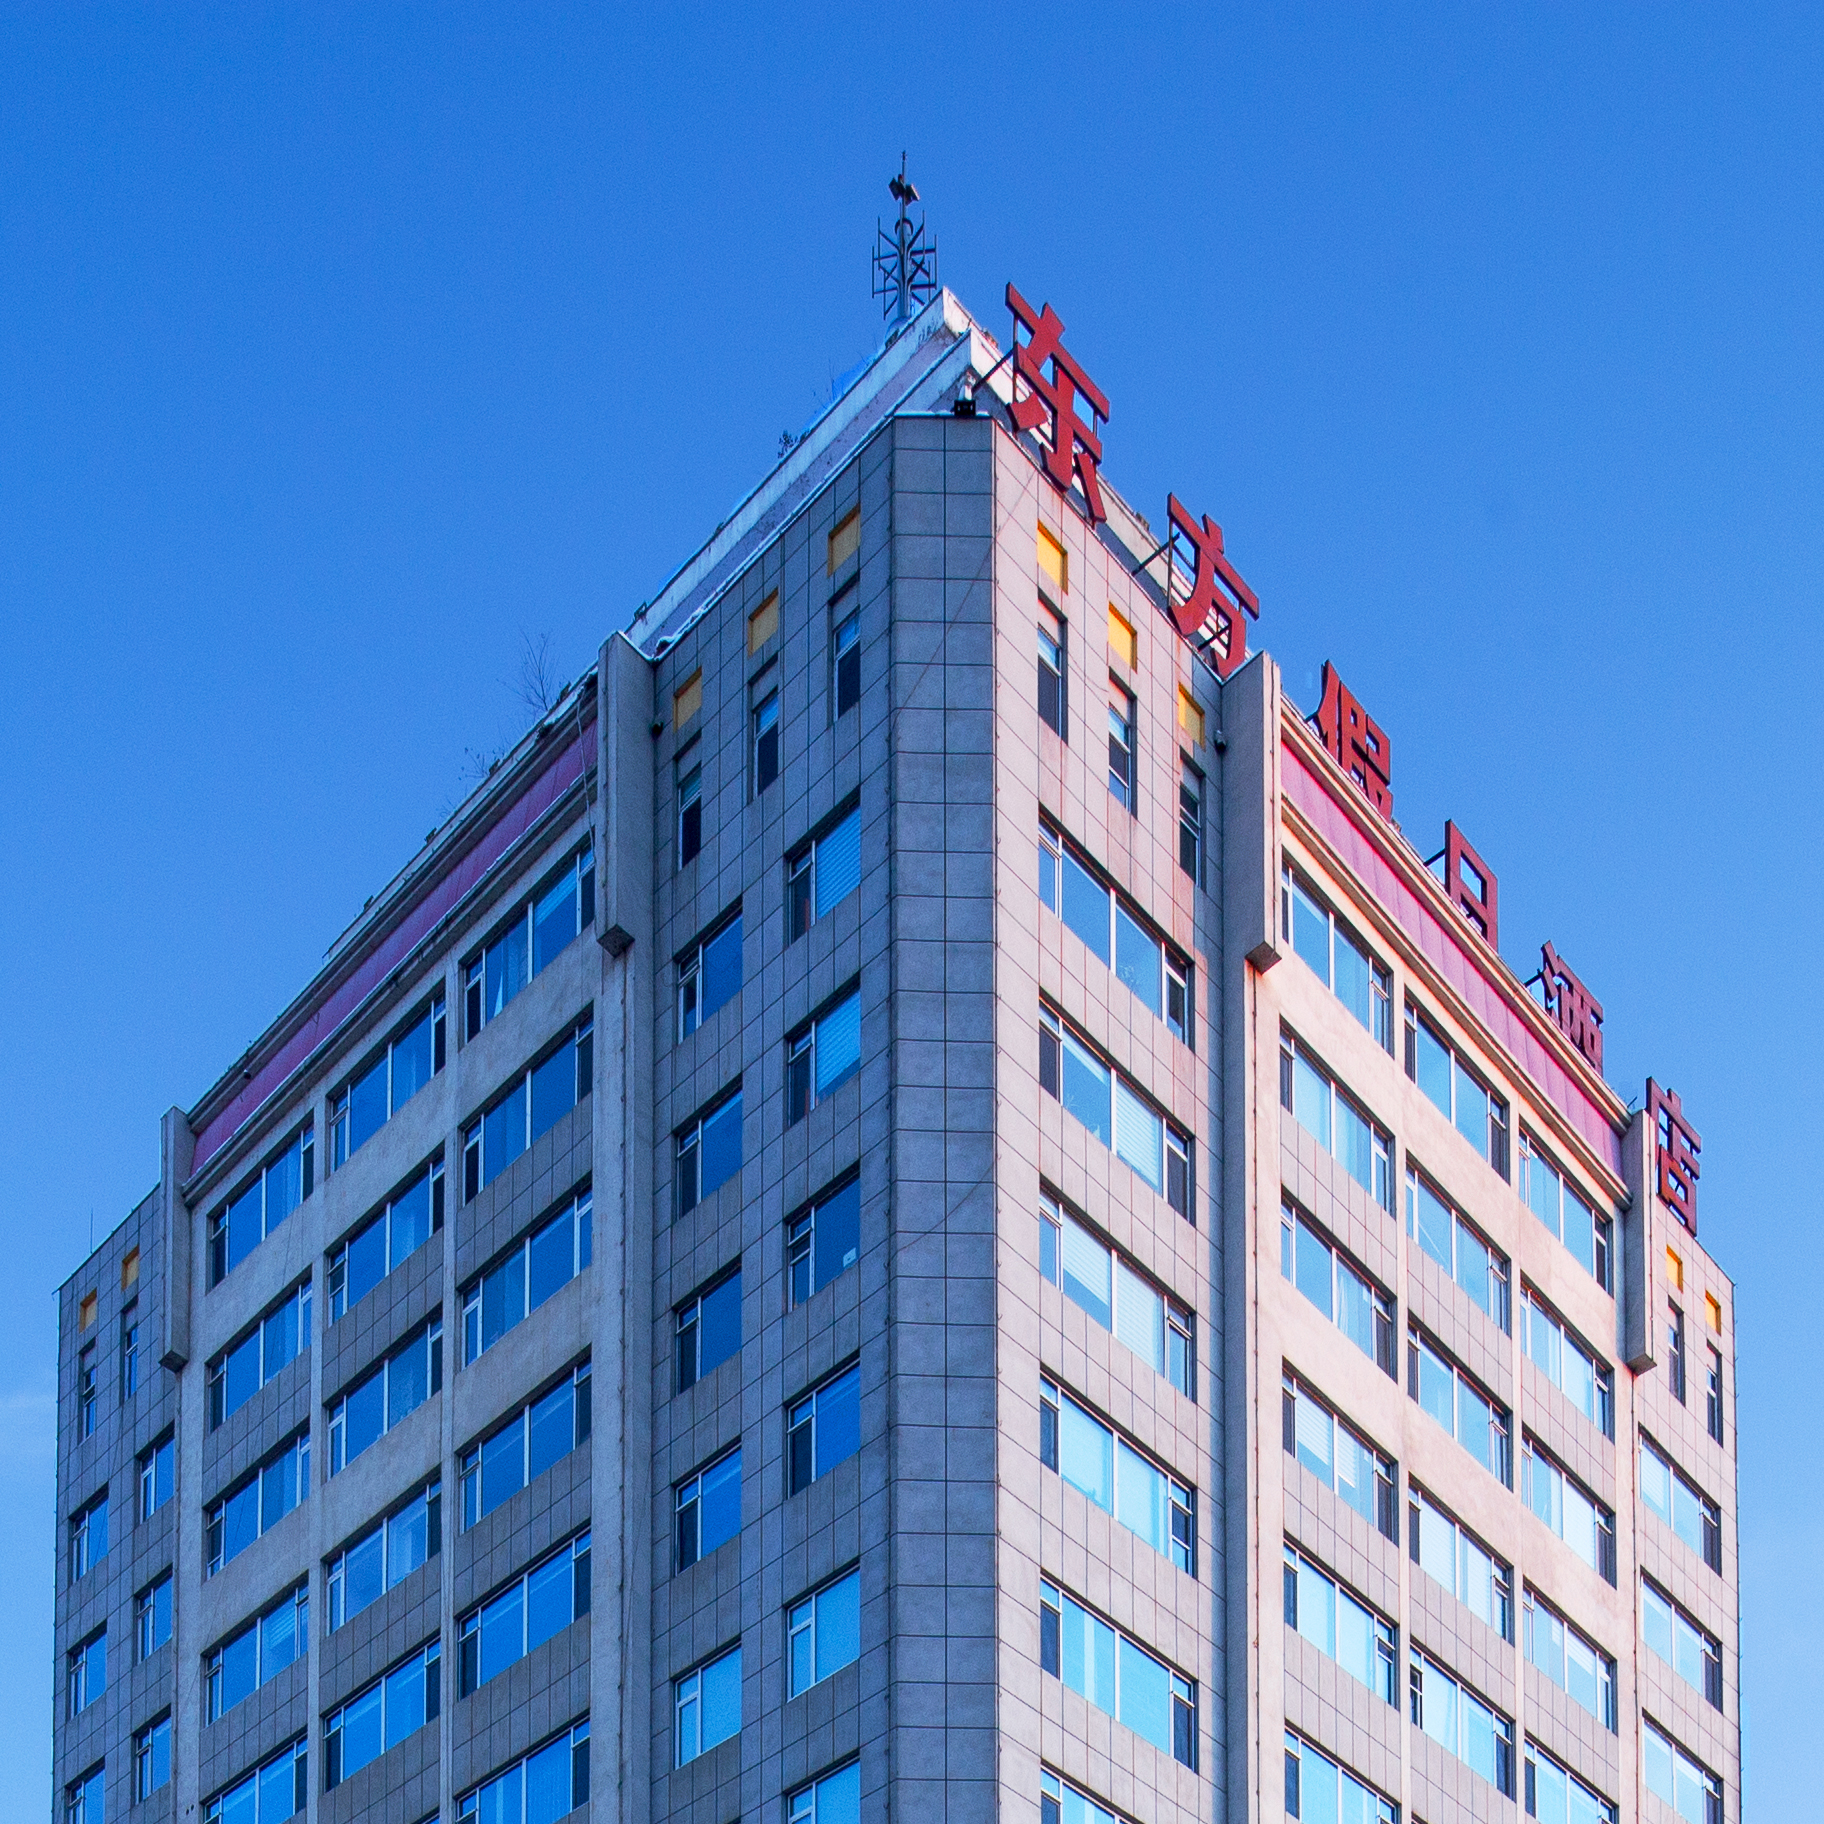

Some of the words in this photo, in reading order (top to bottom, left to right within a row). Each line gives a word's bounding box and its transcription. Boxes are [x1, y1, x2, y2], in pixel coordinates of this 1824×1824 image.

[1005, 282, 1701, 1236] 东方假日酒店
